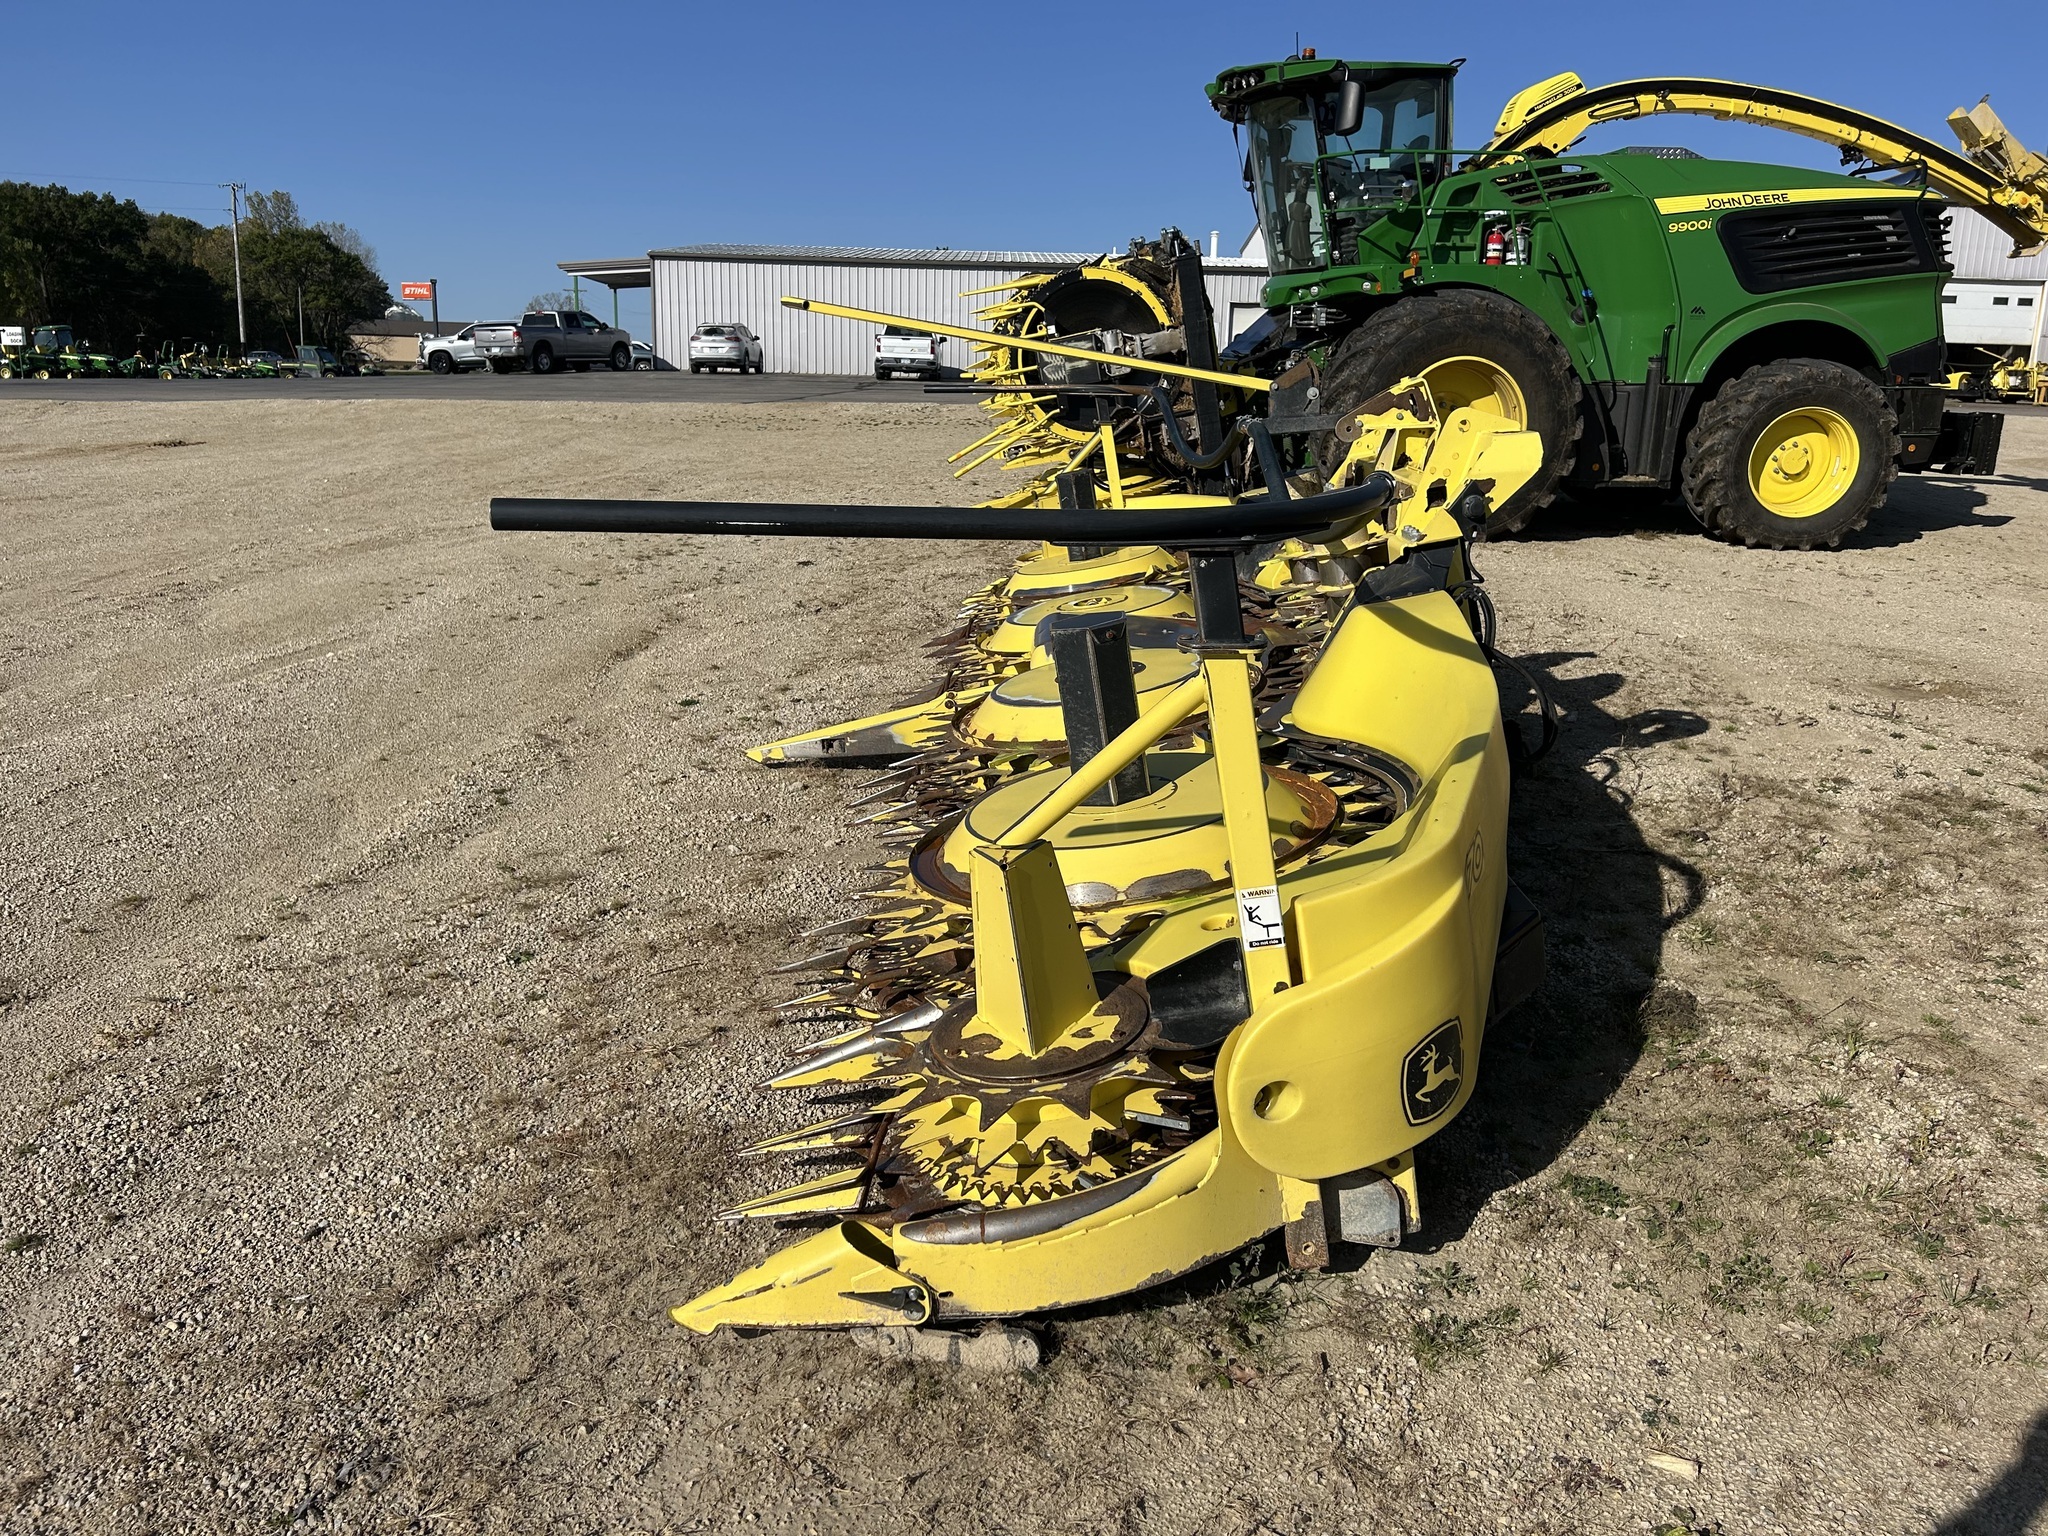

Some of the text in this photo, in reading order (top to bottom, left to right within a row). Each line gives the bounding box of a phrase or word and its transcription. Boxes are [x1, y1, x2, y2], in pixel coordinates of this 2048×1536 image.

[1563, 86, 1577, 96] 3000
[1704, 193, 1791, 210] JOHN DEERE
[1668, 217, 1713, 233] 9900i
[404, 287, 430, 295] STIHL
